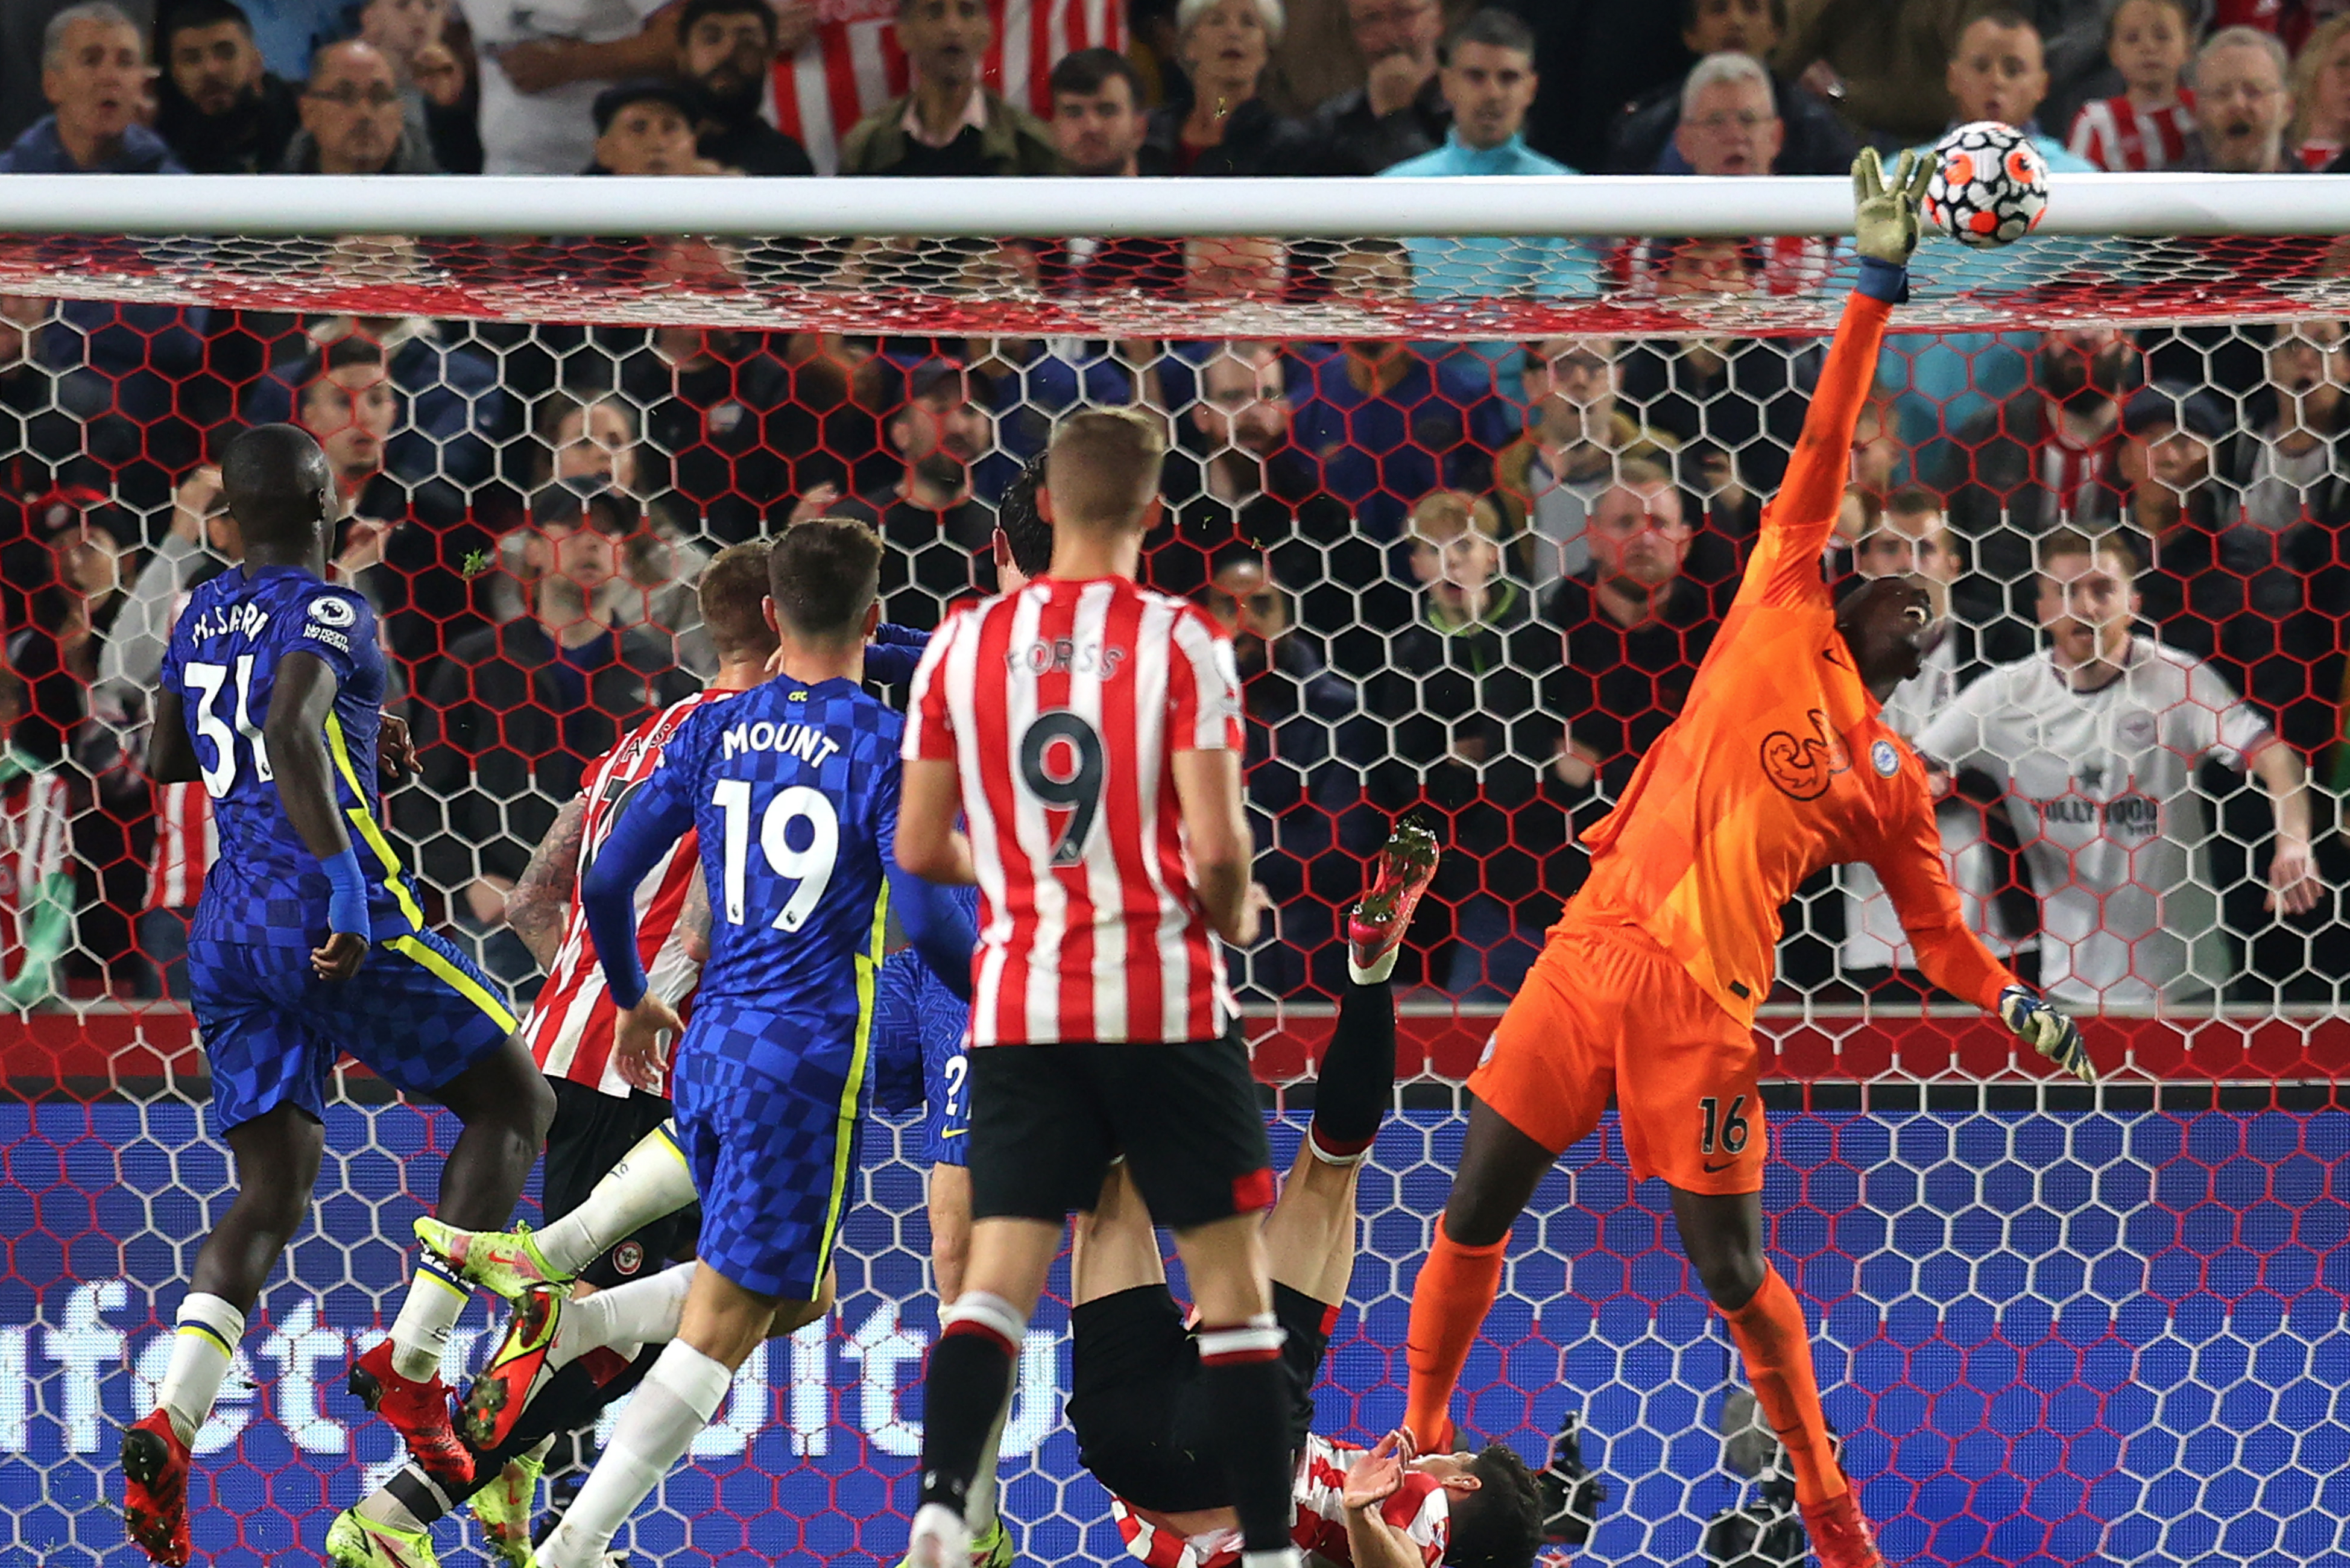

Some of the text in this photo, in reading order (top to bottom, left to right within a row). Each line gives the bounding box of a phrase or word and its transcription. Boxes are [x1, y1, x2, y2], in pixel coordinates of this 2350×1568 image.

[321, 628, 347, 645] room
[723, 722, 839, 768] MOUNT
[1021, 708, 1108, 868] 9
[712, 779, 839, 933] 19
[944, 1055, 972, 1121] 2
[1698, 1095, 1748, 1154] 16
